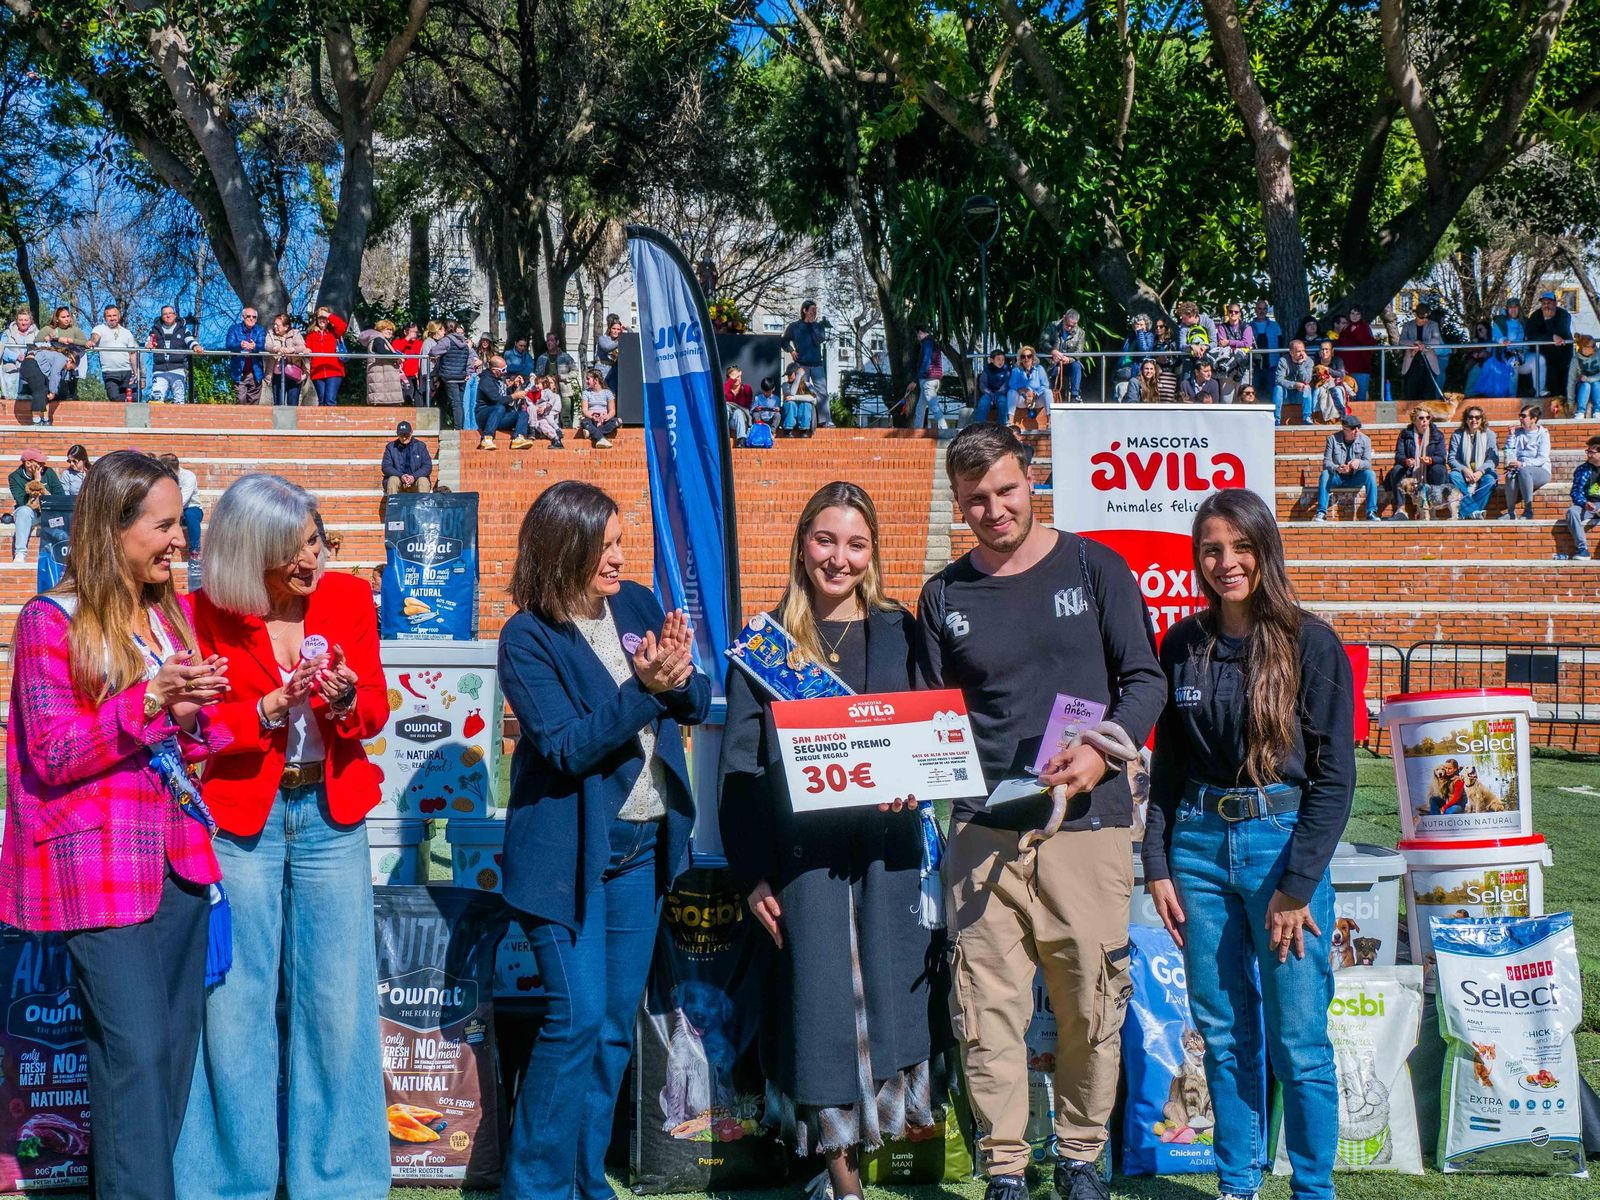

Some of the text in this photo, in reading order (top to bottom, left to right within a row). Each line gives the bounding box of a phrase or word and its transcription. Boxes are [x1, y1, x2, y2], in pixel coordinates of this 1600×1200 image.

[1127, 437, 1209, 448] MASCOTAS
[1107, 499, 1200, 513] Animales felic
[1131, 563, 1205, 599] ÓXI
[411, 588, 442, 597] NATURAL
[1072, 699, 1085, 708] San
[1064, 703, 1091, 718] Antón
[404, 721, 443, 733] ownat
[792, 732, 847, 745] SAN ANTÓN
[1456, 733, 1516, 753] Select
[793, 738, 891, 755] SEGUNDO PREMIO
[407, 750, 445, 760] NATURAL
[795, 752, 849, 762] CHEQUE REGALO
[801, 762, 876, 794] 30€
[1422, 816, 1513, 828] NUTRICIÓN NATURAL
[1467, 884, 1529, 904] Select
[1334, 896, 1380, 920] osbi
[1151, 955, 1187, 989] Go
[1506, 961, 1553, 981] picart
[389, 985, 463, 1006] ownat
[1460, 980, 1558, 1009] Select
[1329, 992, 1385, 1017] osbi
[400, 1009, 414, 1017] THE
[384, 1046, 462, 1059] FRESH meal
[385, 1032, 405, 1048] only
[415, 1038, 437, 1060] NO
[20, 1048, 40, 1064] only
[53, 1053, 77, 1074] NO
[20, 1062, 46, 1073] FRESH
[382, 1057, 409, 1069] MEAT
[20, 1073, 46, 1086] MEAT
[393, 1075, 449, 1091] NATURAL
[31, 1089, 90, 1108] NATURAL
[438, 1096, 475, 1109] 60% FRESH
[1469, 1095, 1503, 1106] EXTRA
[80, 1110, 91, 1119] 60
[1481, 1106, 1503, 1115] CARE
[395, 1155, 446, 1163] DOG FOOD
[891, 1152, 914, 1160] Lamb
[1170, 1149, 1201, 1157] Chicken
[698, 1157, 724, 1166] Puppy
[35, 1165, 88, 1176] DOG FOOD
